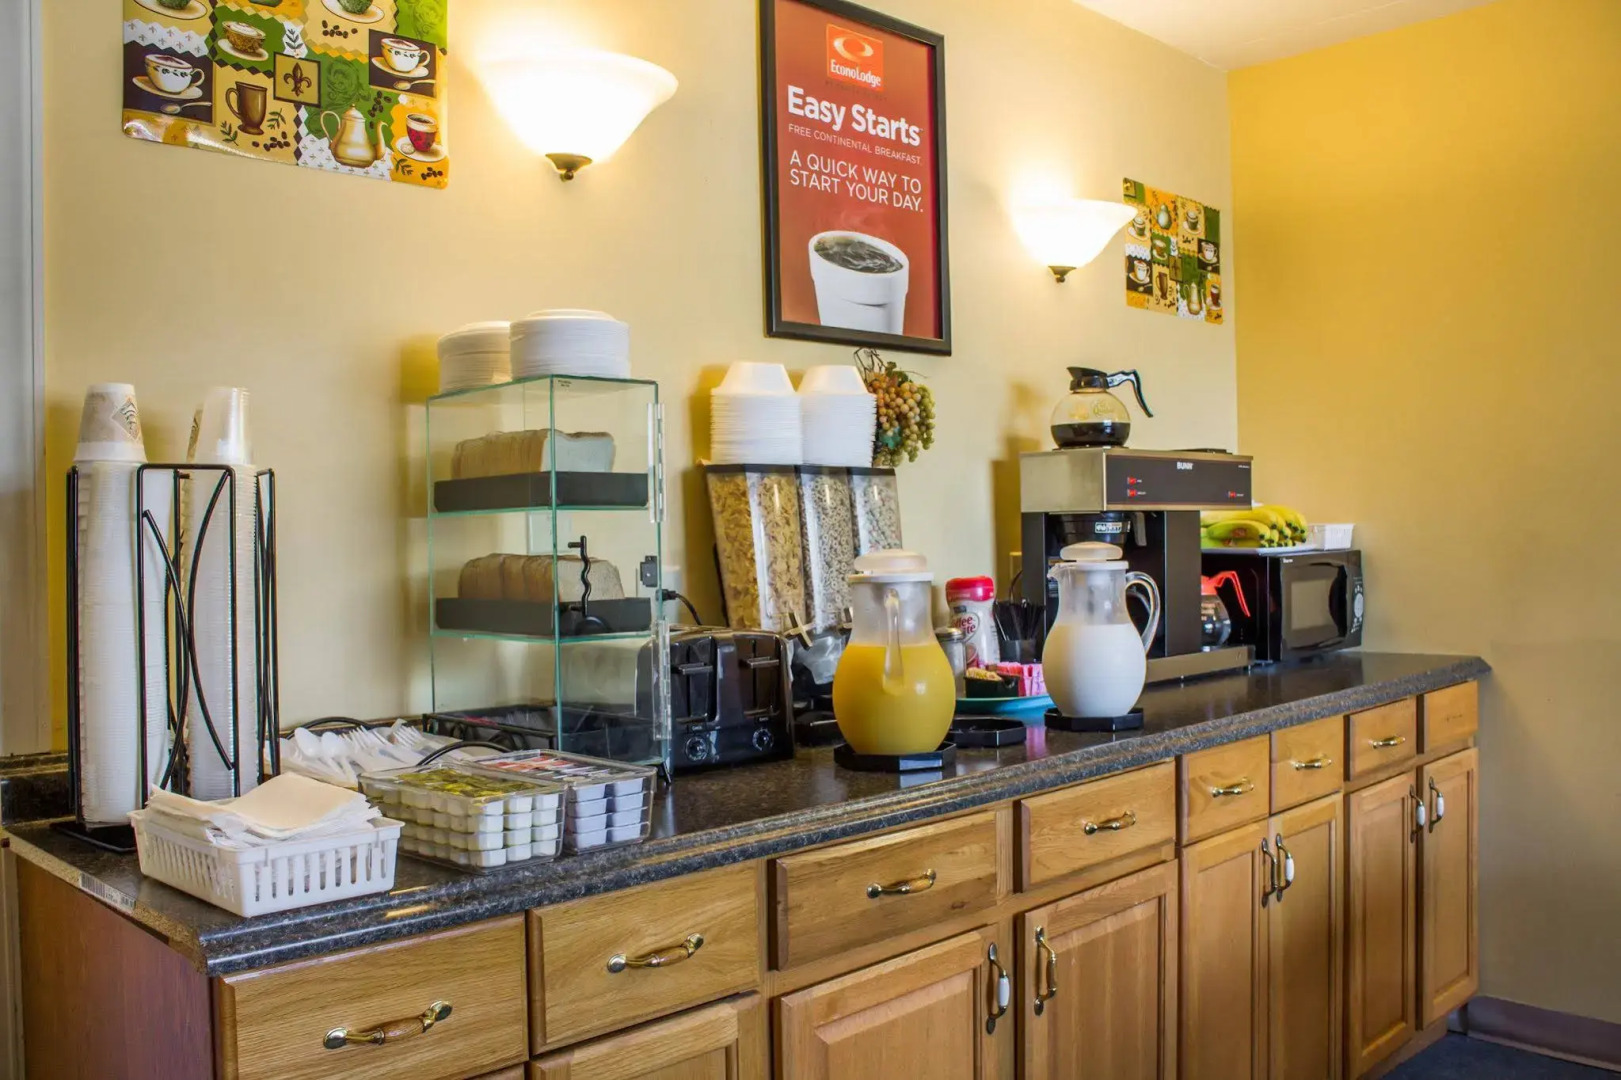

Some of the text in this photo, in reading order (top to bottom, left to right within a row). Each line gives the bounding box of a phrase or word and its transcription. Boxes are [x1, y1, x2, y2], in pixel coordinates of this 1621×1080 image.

[831, 58, 881, 88] EconoLodge
[788, 85, 846, 131] Easy
[851, 103, 921, 147] Starts
[788, 123, 812, 138] FREE
[813, 130, 873, 153] CONTINENTAL
[789, 149, 921, 194] A QUICK WAY TO
[790, 168, 924, 213] START YOUR DAY.
